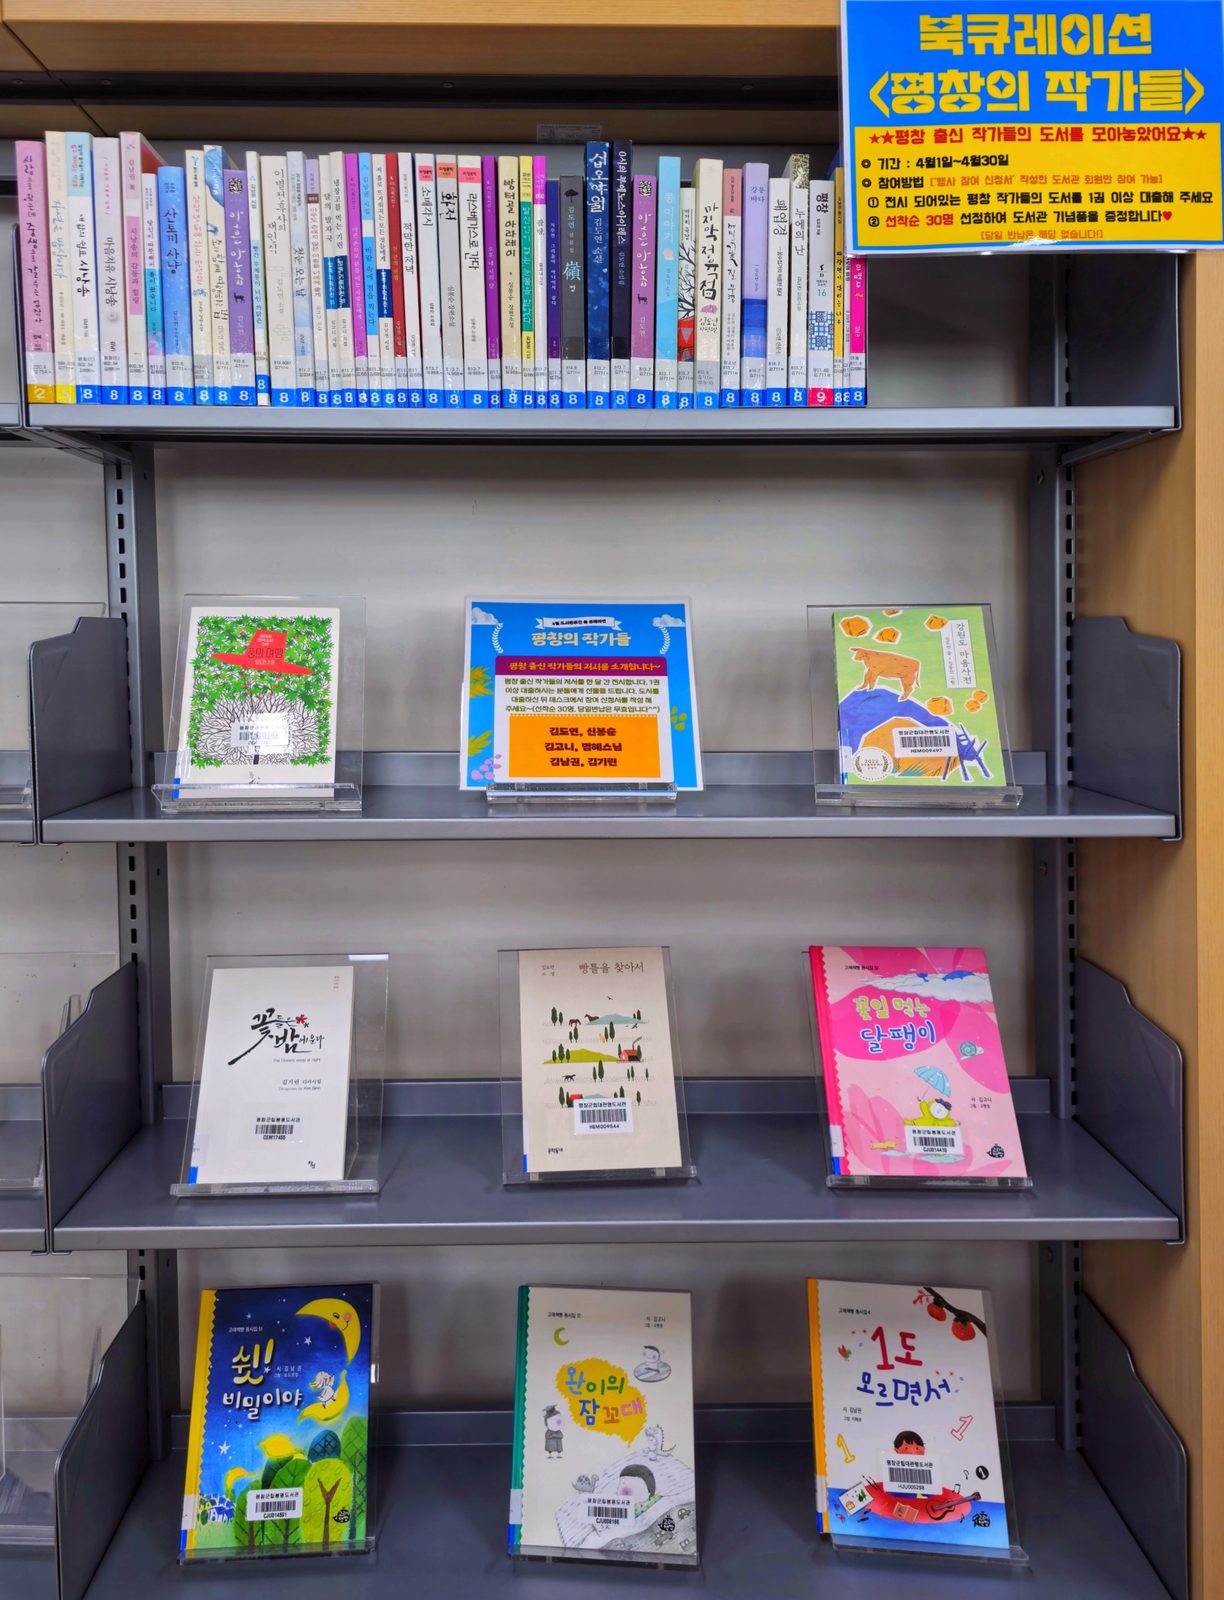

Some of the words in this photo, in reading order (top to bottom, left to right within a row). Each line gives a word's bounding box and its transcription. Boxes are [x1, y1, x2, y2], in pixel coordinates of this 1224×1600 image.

[919, 13, 1152, 56] 북큐레이션
[933, 127, 963, 144] 출신
[972, 126, 1031, 142] 작가들의
[1040, 126, 1084, 142] 도서를
[1092, 126, 1181, 142] 모아놓았어요
[878, 157, 901, 170] 기간
[916, 154, 1009, 169] 4월1일~4월30일
[878, 176, 924, 189] 참여방법
[961, 176, 979, 186] 참여
[1020, 174, 1048, 185] 작성한
[1052, 174, 1079, 185] 도서관
[1085, 174, 1112, 184] 회원만
[1117, 174, 1135, 184] 참여
[421, 186, 434, 227] 소매각시
[439, 191, 459, 221] 화전
[616, 174, 628, 245] 부에노스아이레스
[816, 192, 829, 214] 평창
[885, 196, 908, 209] 전시
[914, 194, 961, 208] 되어있는
[967, 193, 990, 205] 평창
[997, 192, 1042, 204] 작가들의
[1048, 192, 1082, 204] 도서를
[1089, 192, 1105, 204] 1권
[1111, 192, 1134, 204] 이상
[1140, 191, 1174, 204] 대출해
[1180, 191, 1213, 204] 주세요
[164, 207, 178, 245] 산토끼
[466, 193, 480, 249] 라스베가스로
[593, 217, 604, 244] 김도연
[702, 202, 720, 242] 마지막
[773, 199, 788, 236] 패엽경
[886, 214, 920, 228] 선착순
[926, 213, 954, 227] 30명
[960, 212, 1007, 225] 선정하여
[1013, 211, 1047, 223] 도서관
[1053, 211, 1099, 223] 기념품을
[1105, 210, 1162, 223] 증정합니다
[504, 220, 517, 258] 아라레이
[104, 236, 116, 273] 마음치유
[166, 247, 182, 275] 사냥
[464, 252, 480, 270] 간다
[76, 260, 91, 298] 시낭송
[562, 260, 582, 280] 嶺
[699, 245, 719, 301] 정육점
[105, 276, 118, 307] 시낭송
[817, 288, 827, 297] 16
[34, 387, 46, 400] 2
[240, 390, 249, 401] 8
[429, 392, 438, 404] 8
[704, 395, 713, 406] 8
[531, 631, 579, 647] 평창의
[582, 631, 632, 647] 작가들
[509, 662, 528, 671] 평창
[579, 962, 611, 975] 빵틀을
[614, 961, 644, 974] 찾아서
[852, 995, 890, 1021] 꽃잎
[893, 995, 930, 1018] 먹는
[860, 1020, 936, 1054] 달팽이
[231, 1337, 275, 1386] 쉿!
[871, 1325, 924, 1371] 1도
[565, 1366, 626, 1396] 완이의
[856, 1371, 952, 1407] 모르면서
[221, 1388, 304, 1421] 비밀이야
[578, 1397, 645, 1427] 잠꼬대
[951, 1414, 973, 1441] 1
[836, 1432, 856, 1464] 1
